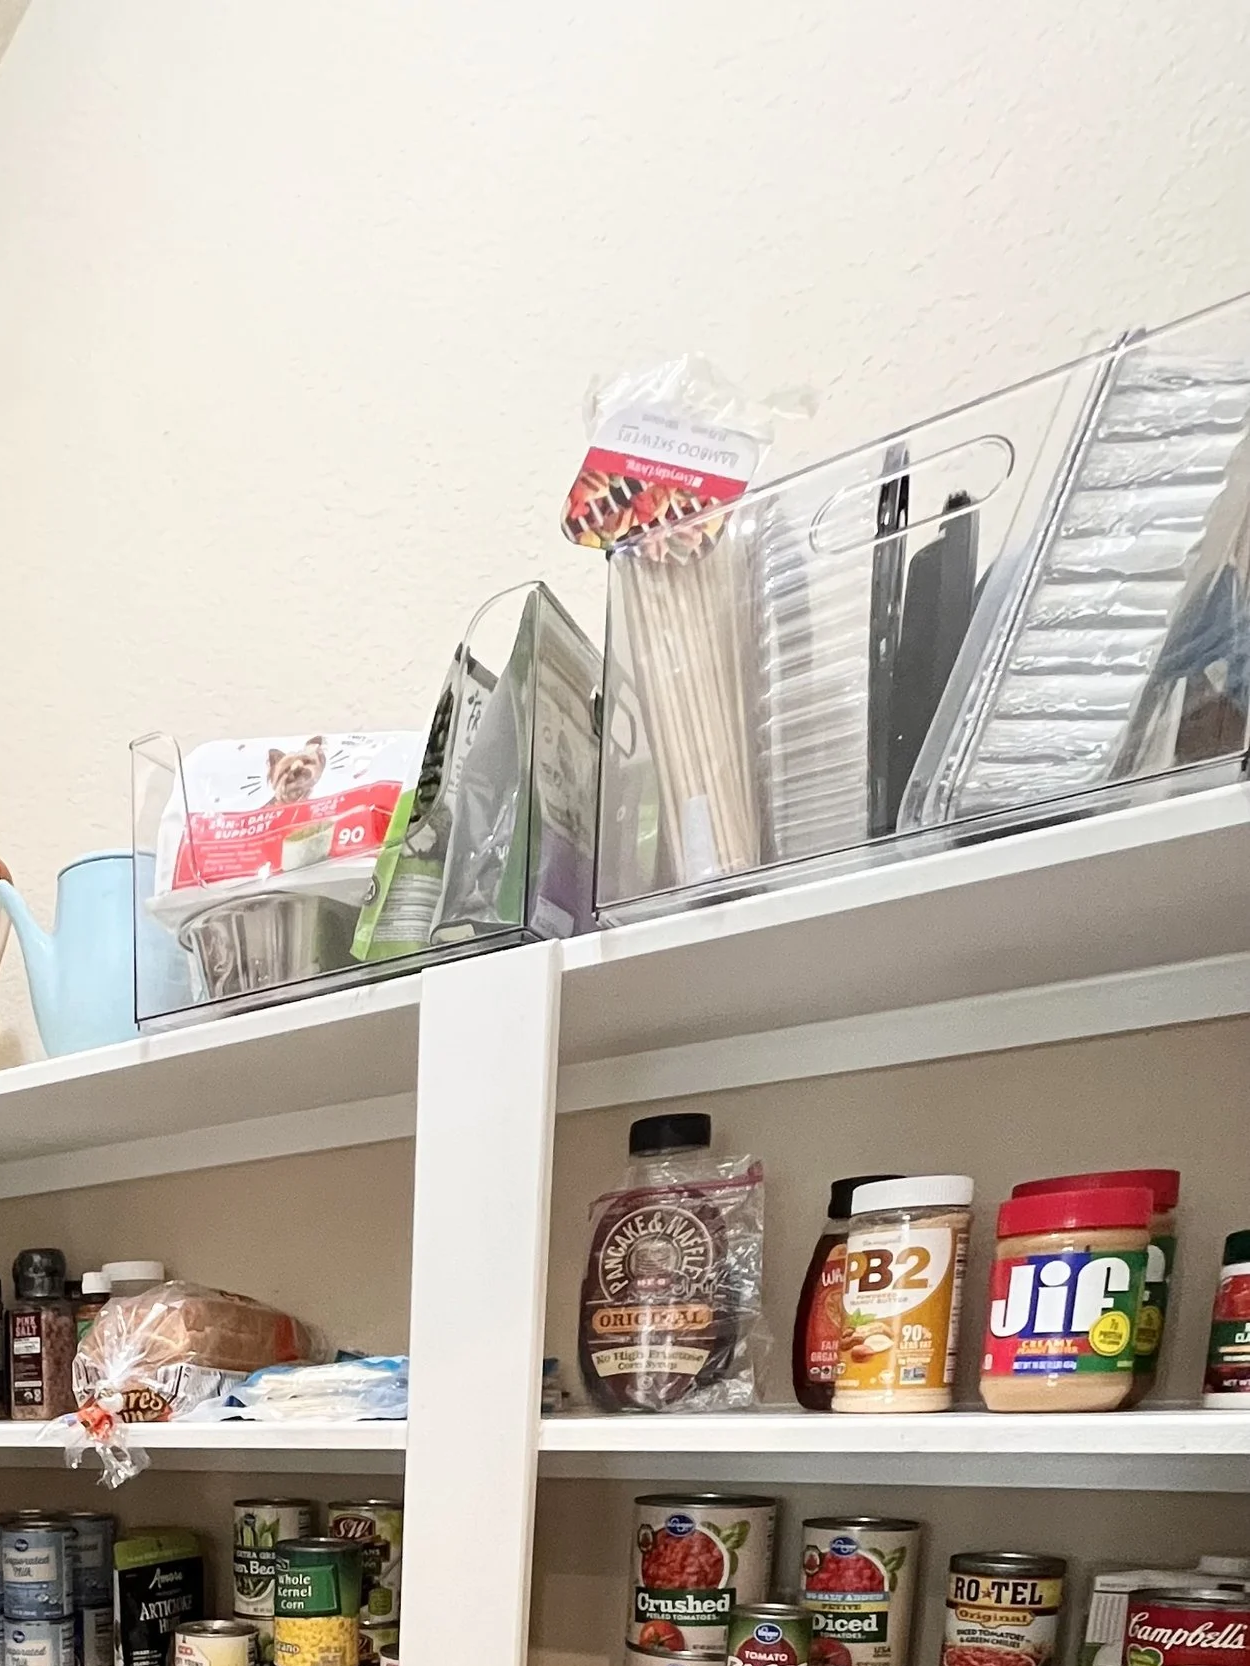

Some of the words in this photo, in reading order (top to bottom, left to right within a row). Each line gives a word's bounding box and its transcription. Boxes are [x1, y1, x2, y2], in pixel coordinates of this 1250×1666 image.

[616, 428, 674, 453] SKEWERS
[677, 441, 739, 469] BAMBOO
[248, 810, 285, 826] DAILY
[214, 820, 273, 840] SUPPORT
[337, 825, 365, 845] 90
[604, 1213, 650, 1296] PANCAKE
[647, 1210, 664, 1233] &
[665, 1215, 706, 1281] WAFFLE
[845, 1246, 931, 1294] PB2
[990, 1256, 1131, 1338] Jif
[15, 1315, 36, 1326] PINK
[15, 1325, 38, 1337] SALT
[1020, 1338, 1073, 1349] CREAMY
[13, 1565, 34, 1578] Milk
[278, 1573, 312, 1586] Whole
[277, 1586, 313, 1598] Kernel
[139, 1594, 193, 1622] ARTICHOKE
[280, 1599, 305, 1610] Corn
[637, 1592, 731, 1614] Crushed
[646, 1612, 672, 1620] PEELED
[672, 1613, 718, 1621] TOMATOES
[812, 1613, 879, 1633] Diced
[958, 1608, 1030, 1625] Original
[1128, 1611, 1249, 1650] Campbell's
[744, 1650, 788, 1662] TOMATO
